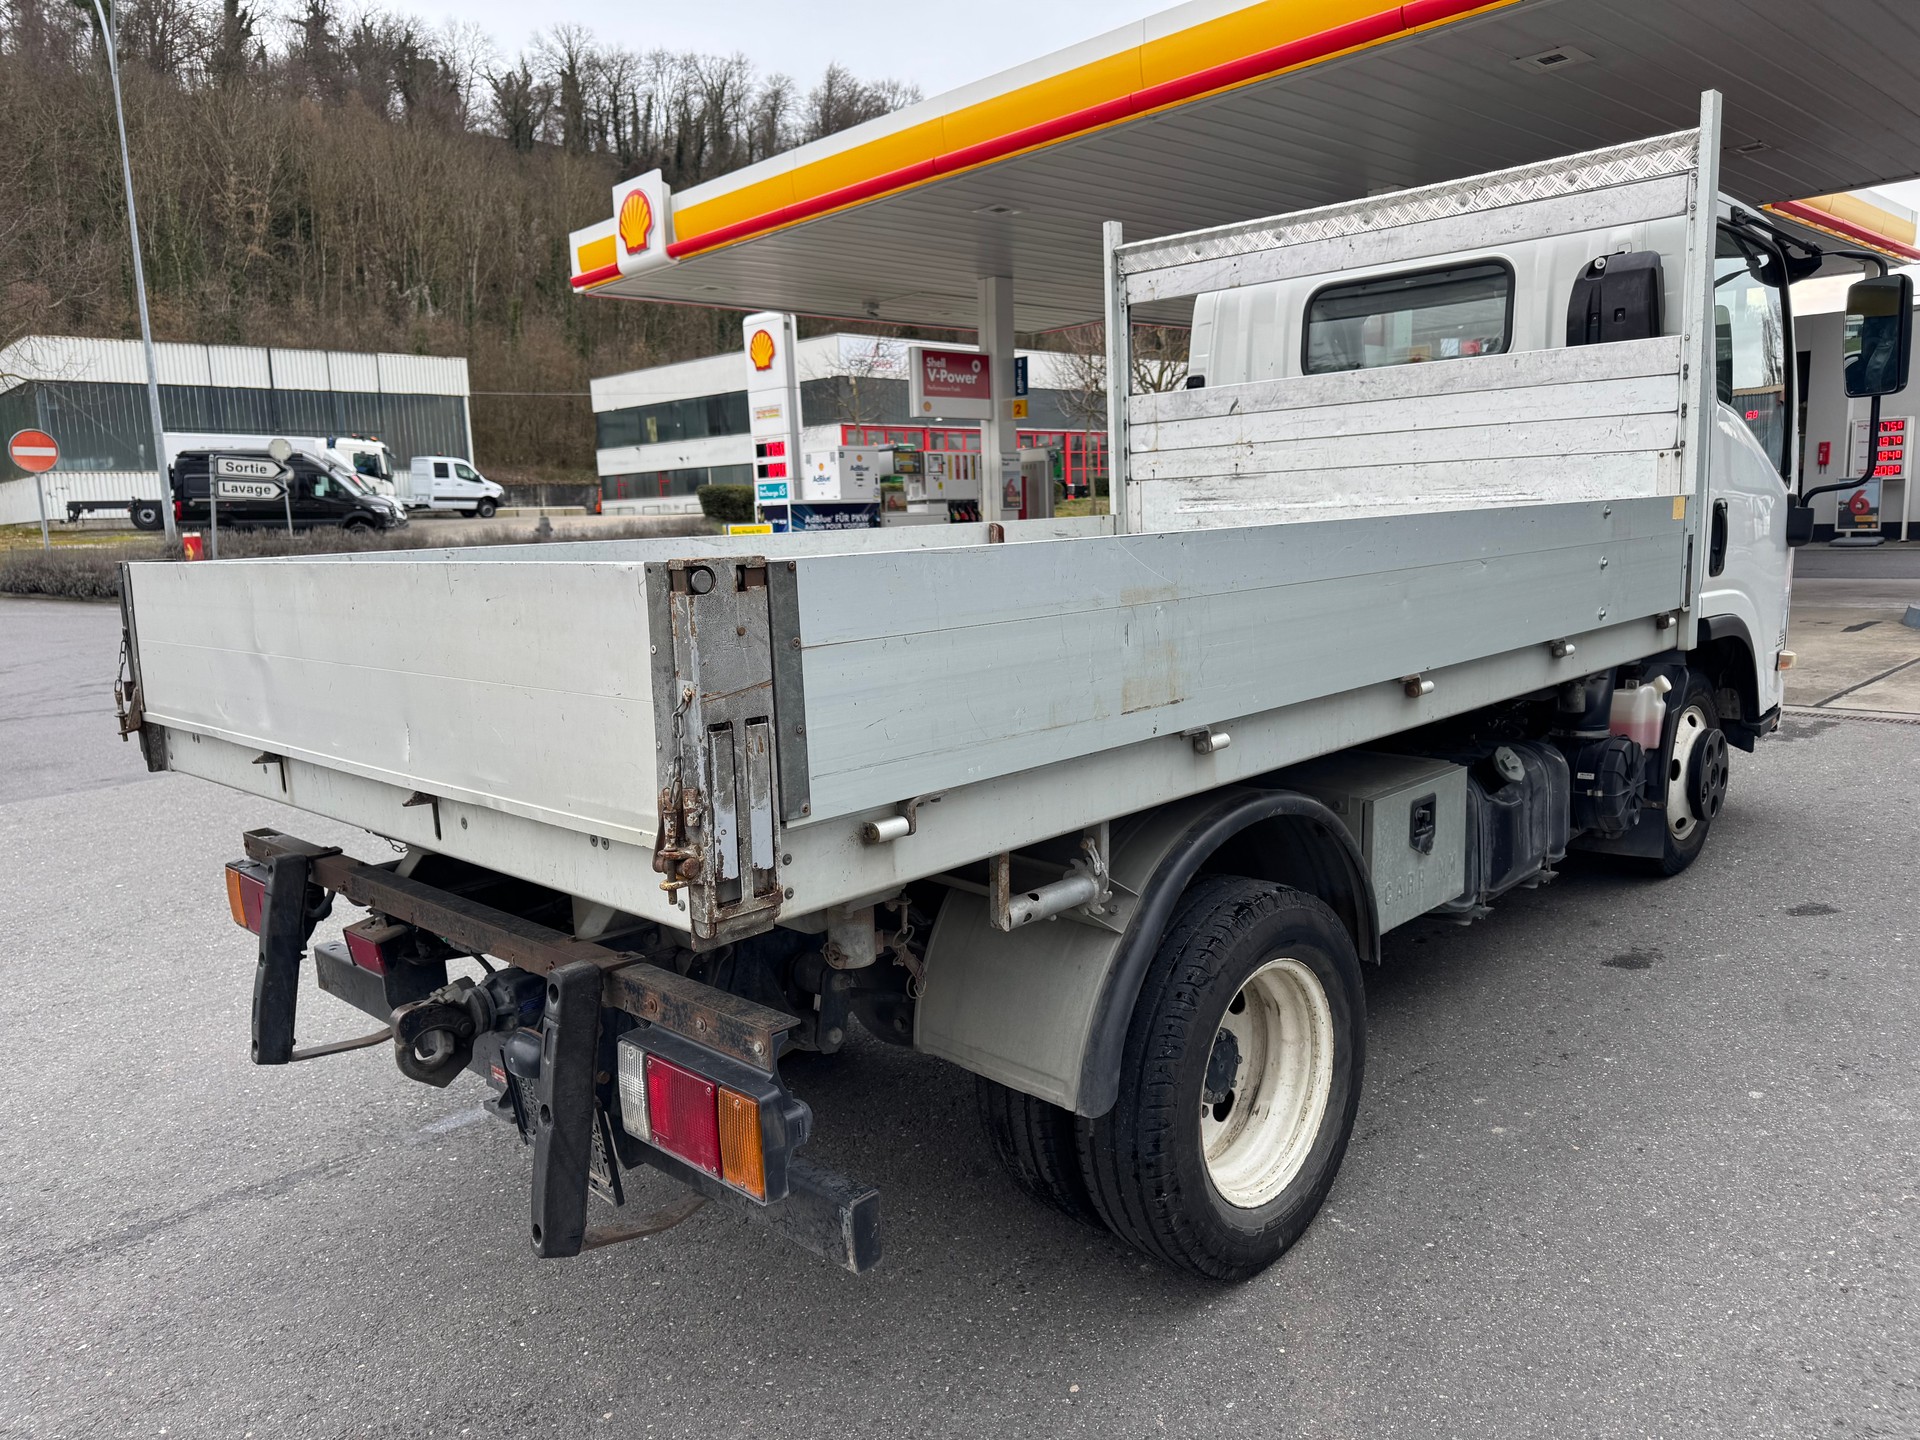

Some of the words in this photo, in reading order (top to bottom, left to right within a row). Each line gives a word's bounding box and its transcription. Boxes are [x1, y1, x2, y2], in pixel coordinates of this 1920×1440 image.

[926, 357, 946, 368] Shell
[927, 368, 977, 384] V-Power
[1015, 403, 1021, 415] 2
[225, 461, 267, 474] Sortie
[813, 475, 831, 483] AdBlue
[222, 482, 271, 497] Lavage
[1849, 489, 1870, 515] 6
[804, 514, 833, 524] AdBlue
[834, 512, 851, 523] FÜR
[851, 513, 870, 522] PKW
